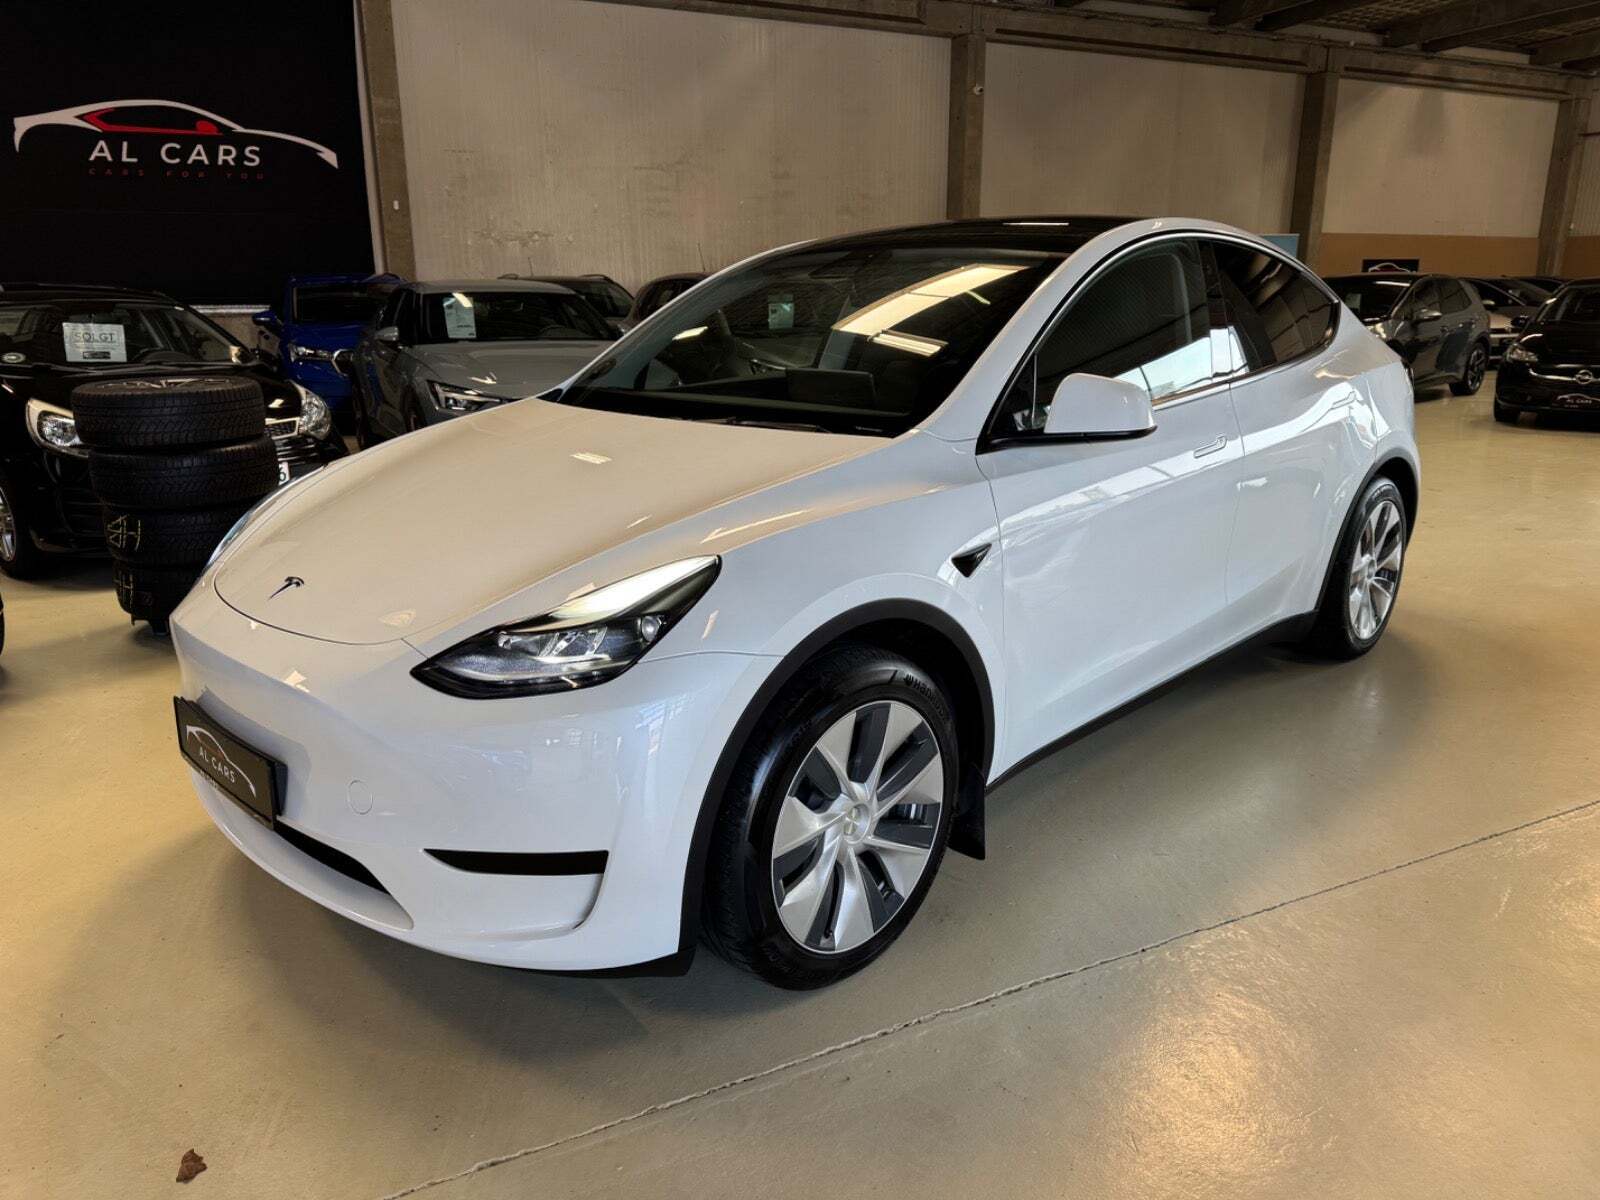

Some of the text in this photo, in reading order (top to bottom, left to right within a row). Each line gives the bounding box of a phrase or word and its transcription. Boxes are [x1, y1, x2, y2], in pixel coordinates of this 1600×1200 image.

[89, 140, 260, 167] AL CARS
[74, 332, 116, 343] SOLGT
[199, 747, 210, 762] AL
[211, 757, 235, 783] CARS
